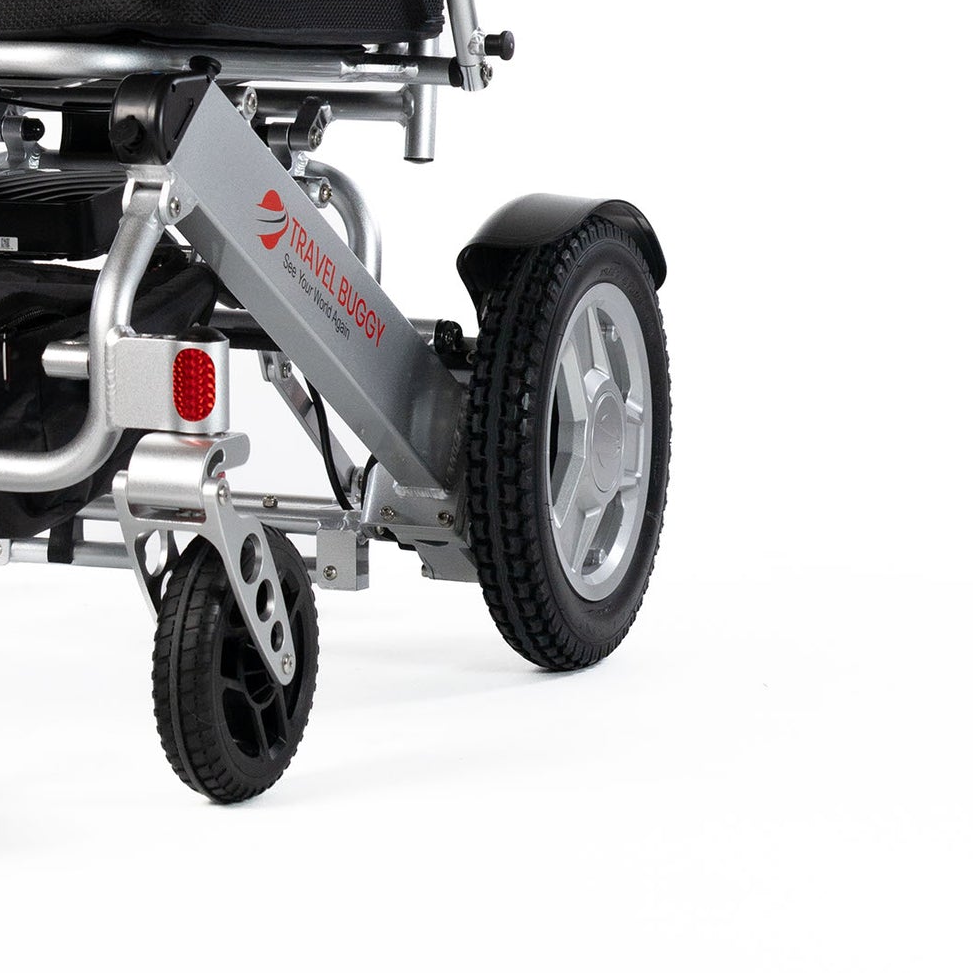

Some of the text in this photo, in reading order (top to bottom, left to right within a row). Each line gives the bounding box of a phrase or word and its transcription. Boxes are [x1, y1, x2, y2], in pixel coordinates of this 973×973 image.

[282, 252, 351, 341] See Your World Again
[289, 217, 386, 348] TRAVEL BUGGY
